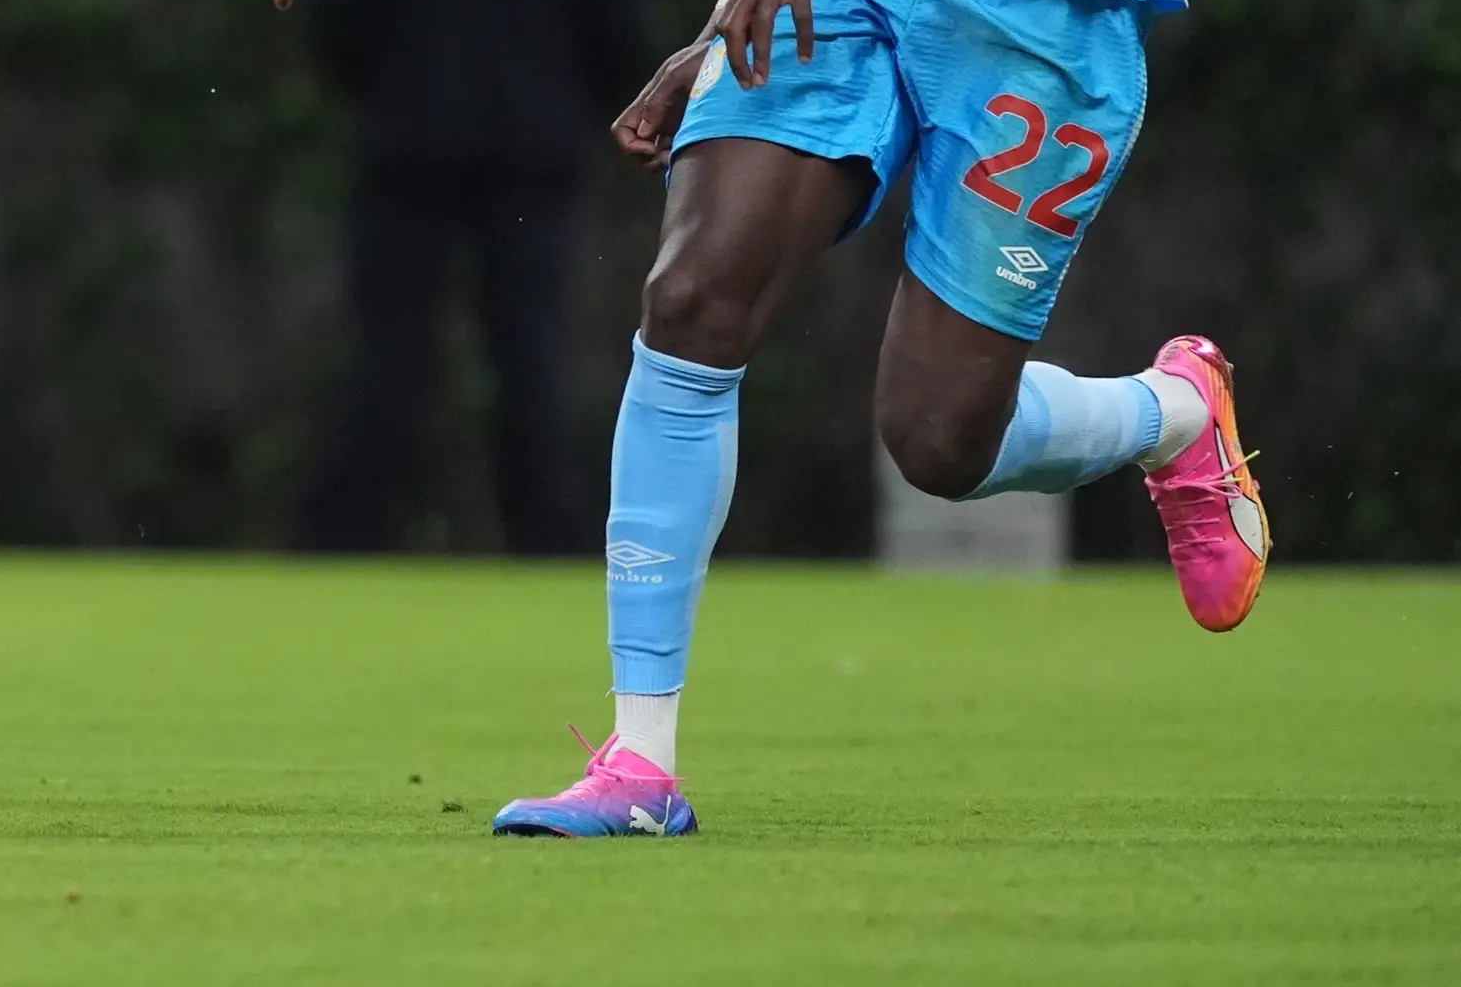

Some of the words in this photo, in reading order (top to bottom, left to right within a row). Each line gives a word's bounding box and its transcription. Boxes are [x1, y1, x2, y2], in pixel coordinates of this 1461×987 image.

[960, 93, 1111, 239] 22
[996, 265, 1038, 291] umbro
[608, 569, 663, 583] mbro
